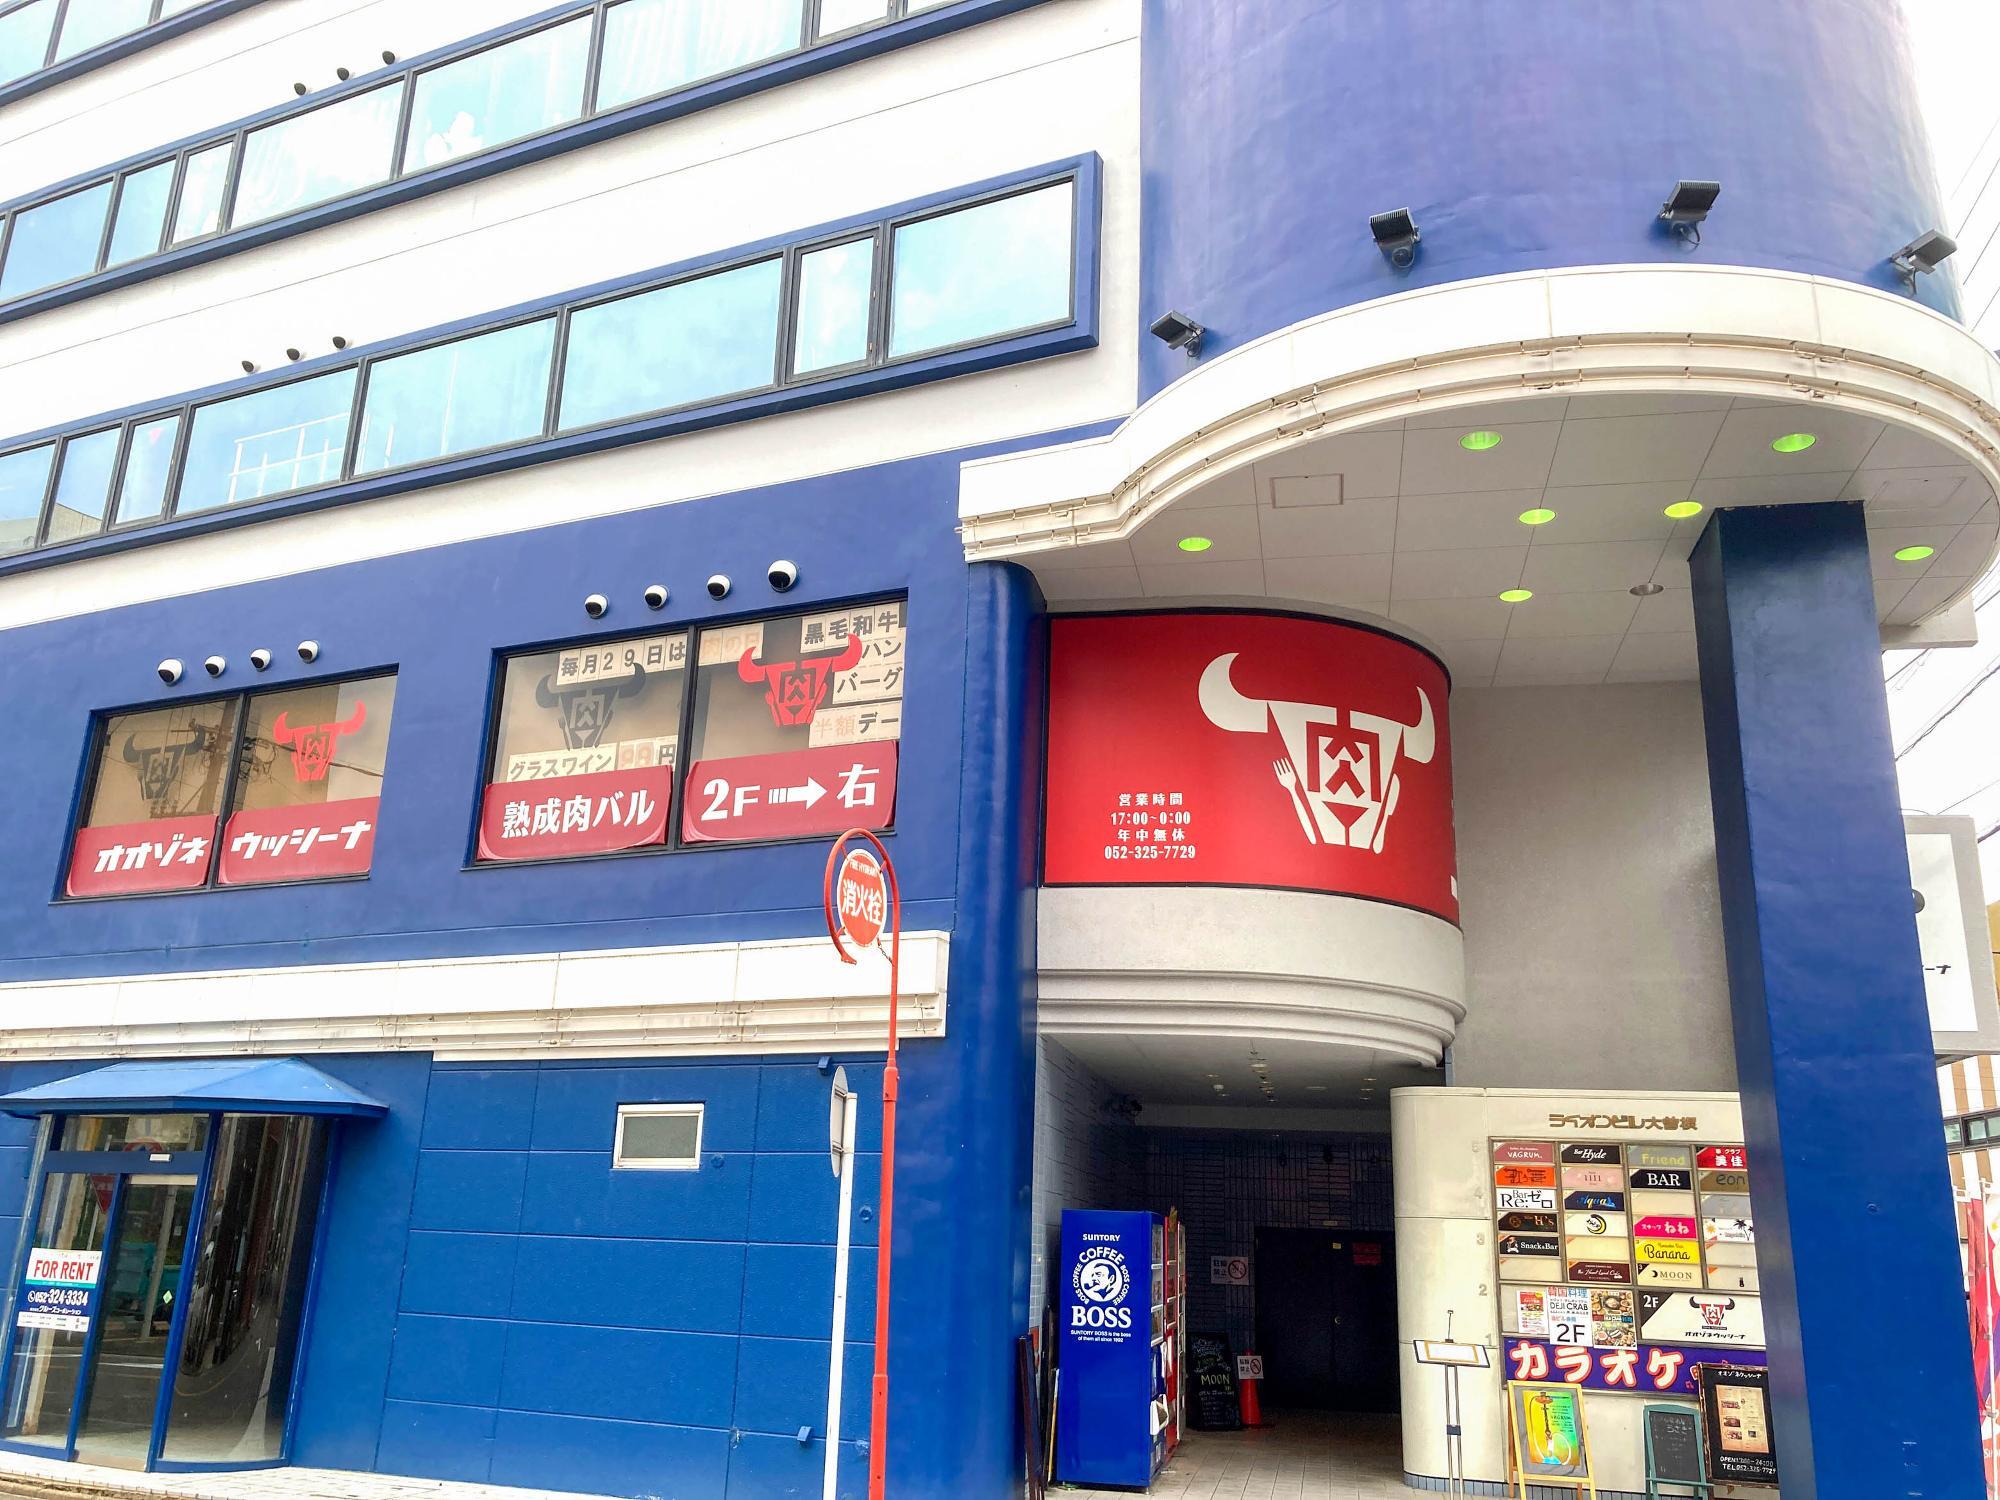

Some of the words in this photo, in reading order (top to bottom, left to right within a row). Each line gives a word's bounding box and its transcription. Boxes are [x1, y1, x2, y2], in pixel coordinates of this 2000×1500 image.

[804, 610, 899, 645] 黒毛和牛
[560, 641, 686, 676] 毎月29日は
[837, 666, 903, 694] バーグ
[814, 711, 900, 740] 半額デー
[510, 754, 612, 781] グラスワイン
[700, 778, 761, 821] 2F
[837, 763, 880, 808] 右
[1119, 792, 1183, 807] 営業時間
[501, 789, 655, 838] 熟成肉バル
[231, 820, 371, 860] ウッシーナ
[1117, 828, 1186, 842] 年中無休
[94, 834, 209, 873] オオゾネ
[1104, 844, 1196, 860] 052-325-7729
[842, 878, 883, 926] 消火栓
[1581, 1148, 1607, 1161] Hyde
[1641, 1153, 1685, 1165] Friend
[1646, 1172, 1681, 1187] BAR
[1512, 1189, 1528, 1199] Bar
[1079, 1247, 1124, 1265] COFFEE
[1644, 1244, 1690, 1260] Banana
[33, 1260, 59, 1279] FOR
[60, 1261, 94, 1280] RENT
[1072, 1263, 1083, 1288] COFFEE
[1120, 1264, 1130, 1283] BOSS
[1660, 1271, 1692, 1279] MOON
[1075, 1288, 1090, 1305] BOSS
[1112, 1283, 1130, 1306] COFFEE
[1479, 1284, 1488, 1297] 2
[1566, 1302, 1588, 1311] CRAB
[1643, 1294, 1659, 1308] 2F
[1071, 1305, 1132, 1329] BOSS
[1556, 1323, 1585, 1343] 2F
[1510, 1340, 1684, 1389] カラオケ
[1201, 1374, 1230, 1386] MOON
